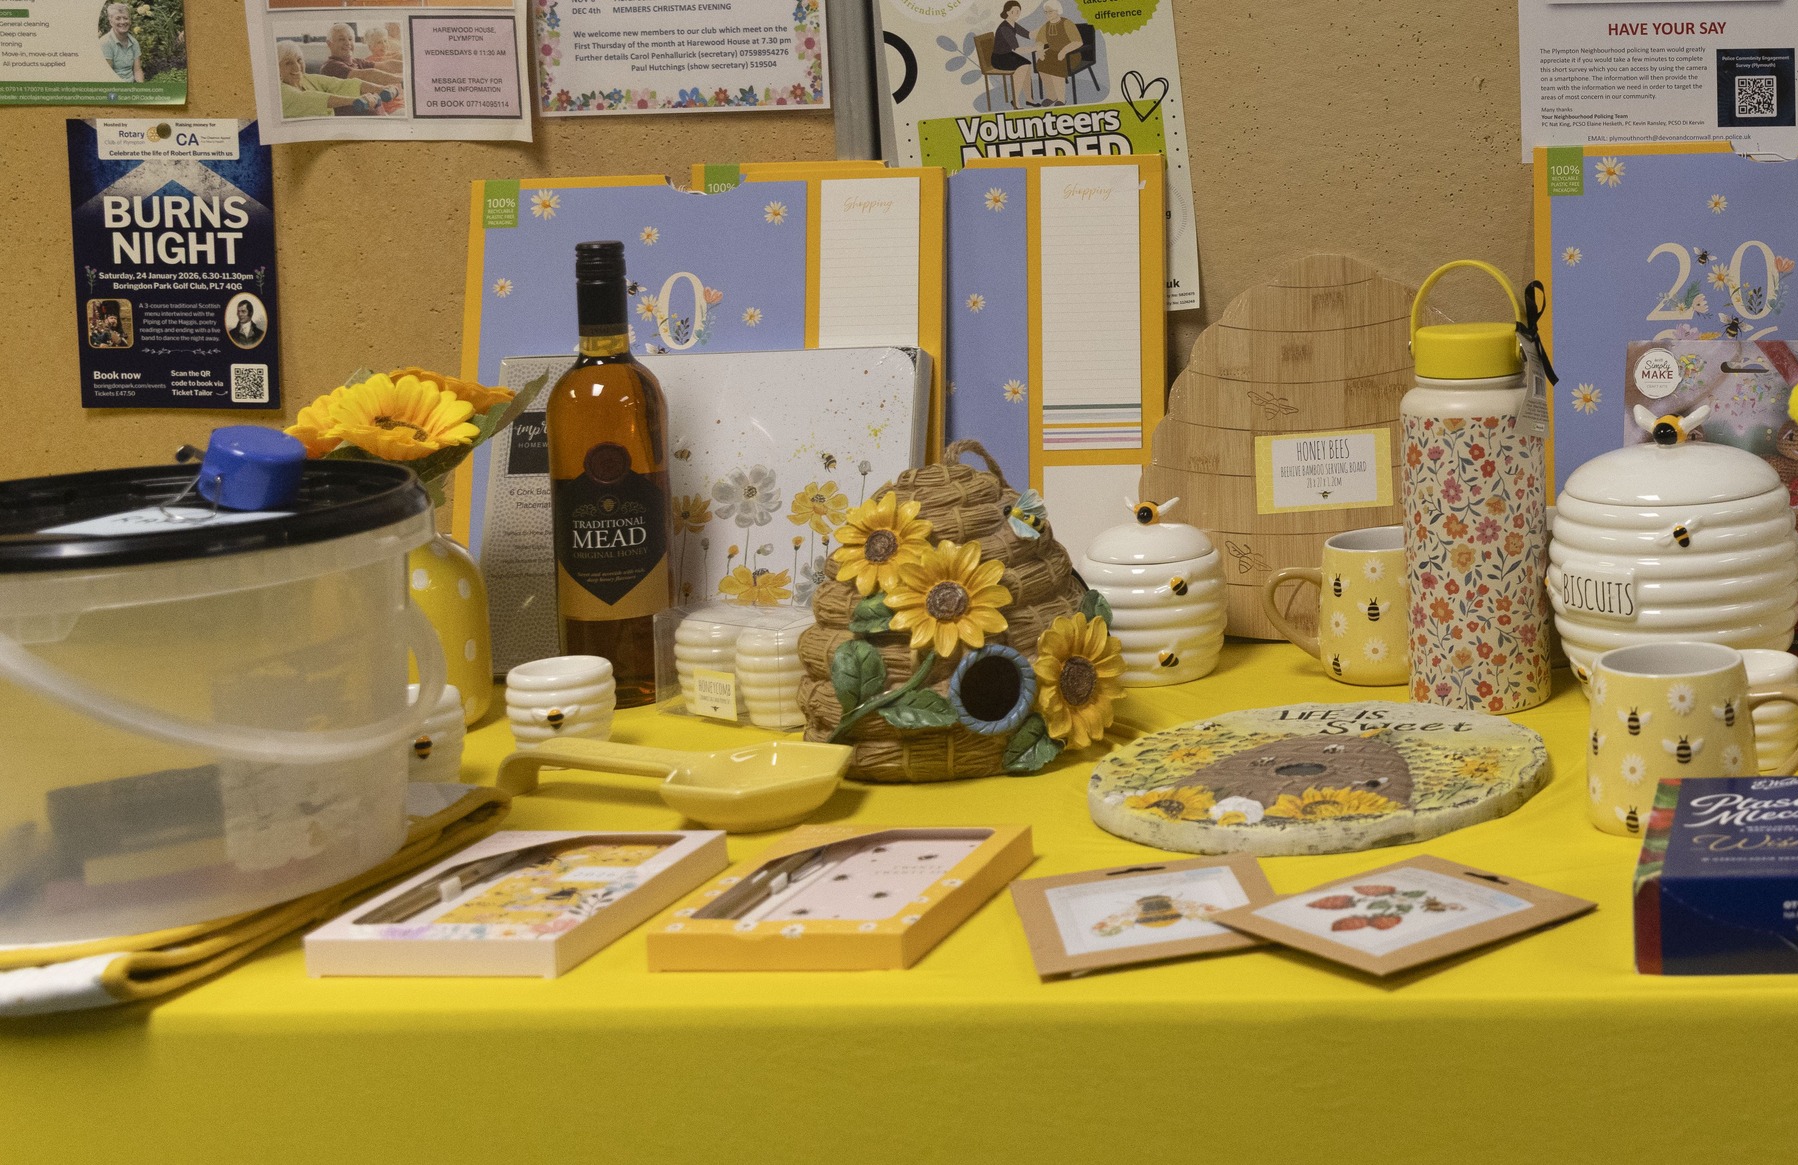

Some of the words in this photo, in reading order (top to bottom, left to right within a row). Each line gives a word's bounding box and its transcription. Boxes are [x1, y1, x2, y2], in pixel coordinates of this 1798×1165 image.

[653, 4, 696, 12] CHRISTMAS
[1094, 8, 1142, 20] difference
[1609, 23, 1648, 36] HAVE
[1653, 22, 1695, 35] YOUR
[1700, 22, 1726, 34] SAY
[957, 108, 1120, 144] Volunteers
[119, 130, 145, 139] Rotary
[176, 133, 199, 146] CA
[1550, 166, 1580, 175] 100%
[708, 183, 736, 193] 100%
[1064, 183, 1113, 200] Shopping
[487, 198, 516, 208] 100%
[844, 197, 894, 213] Shopping
[103, 196, 249, 229] BURNS
[112, 232, 243, 265] NIGHT
[99, 272, 135, 280] Saturday,
[148, 272, 177, 280] January
[202, 272, 254, 281] 6.30-11.30pm
[1646, 240, 1779, 320] 20
[113, 282, 153, 291] Boringdon
[1645, 360, 1670, 372] Simply
[94, 371, 119, 380] Book
[1641, 370, 1673, 380] MAKE
[1296, 440, 1326, 461] HONEY
[1330, 438, 1350, 459] BEES
[1281, 465, 1301, 477] BEEHIVE
[1302, 464, 1324, 476] BAMBOO
[1326, 462, 1348, 475] SERVING
[1350, 461, 1366, 473] BOARD
[573, 516, 646, 529] TRADITIONAL
[572, 527, 647, 548] MEAD
[574, 550, 615, 559] ORIGINAL
[618, 547, 647, 556] HONEY
[1563, 573, 1634, 616] BISCUITS
[1276, 709, 1344, 720] LIFE
[1355, 710, 1389, 720] IS
[1320, 720, 1473, 735] Sweet
